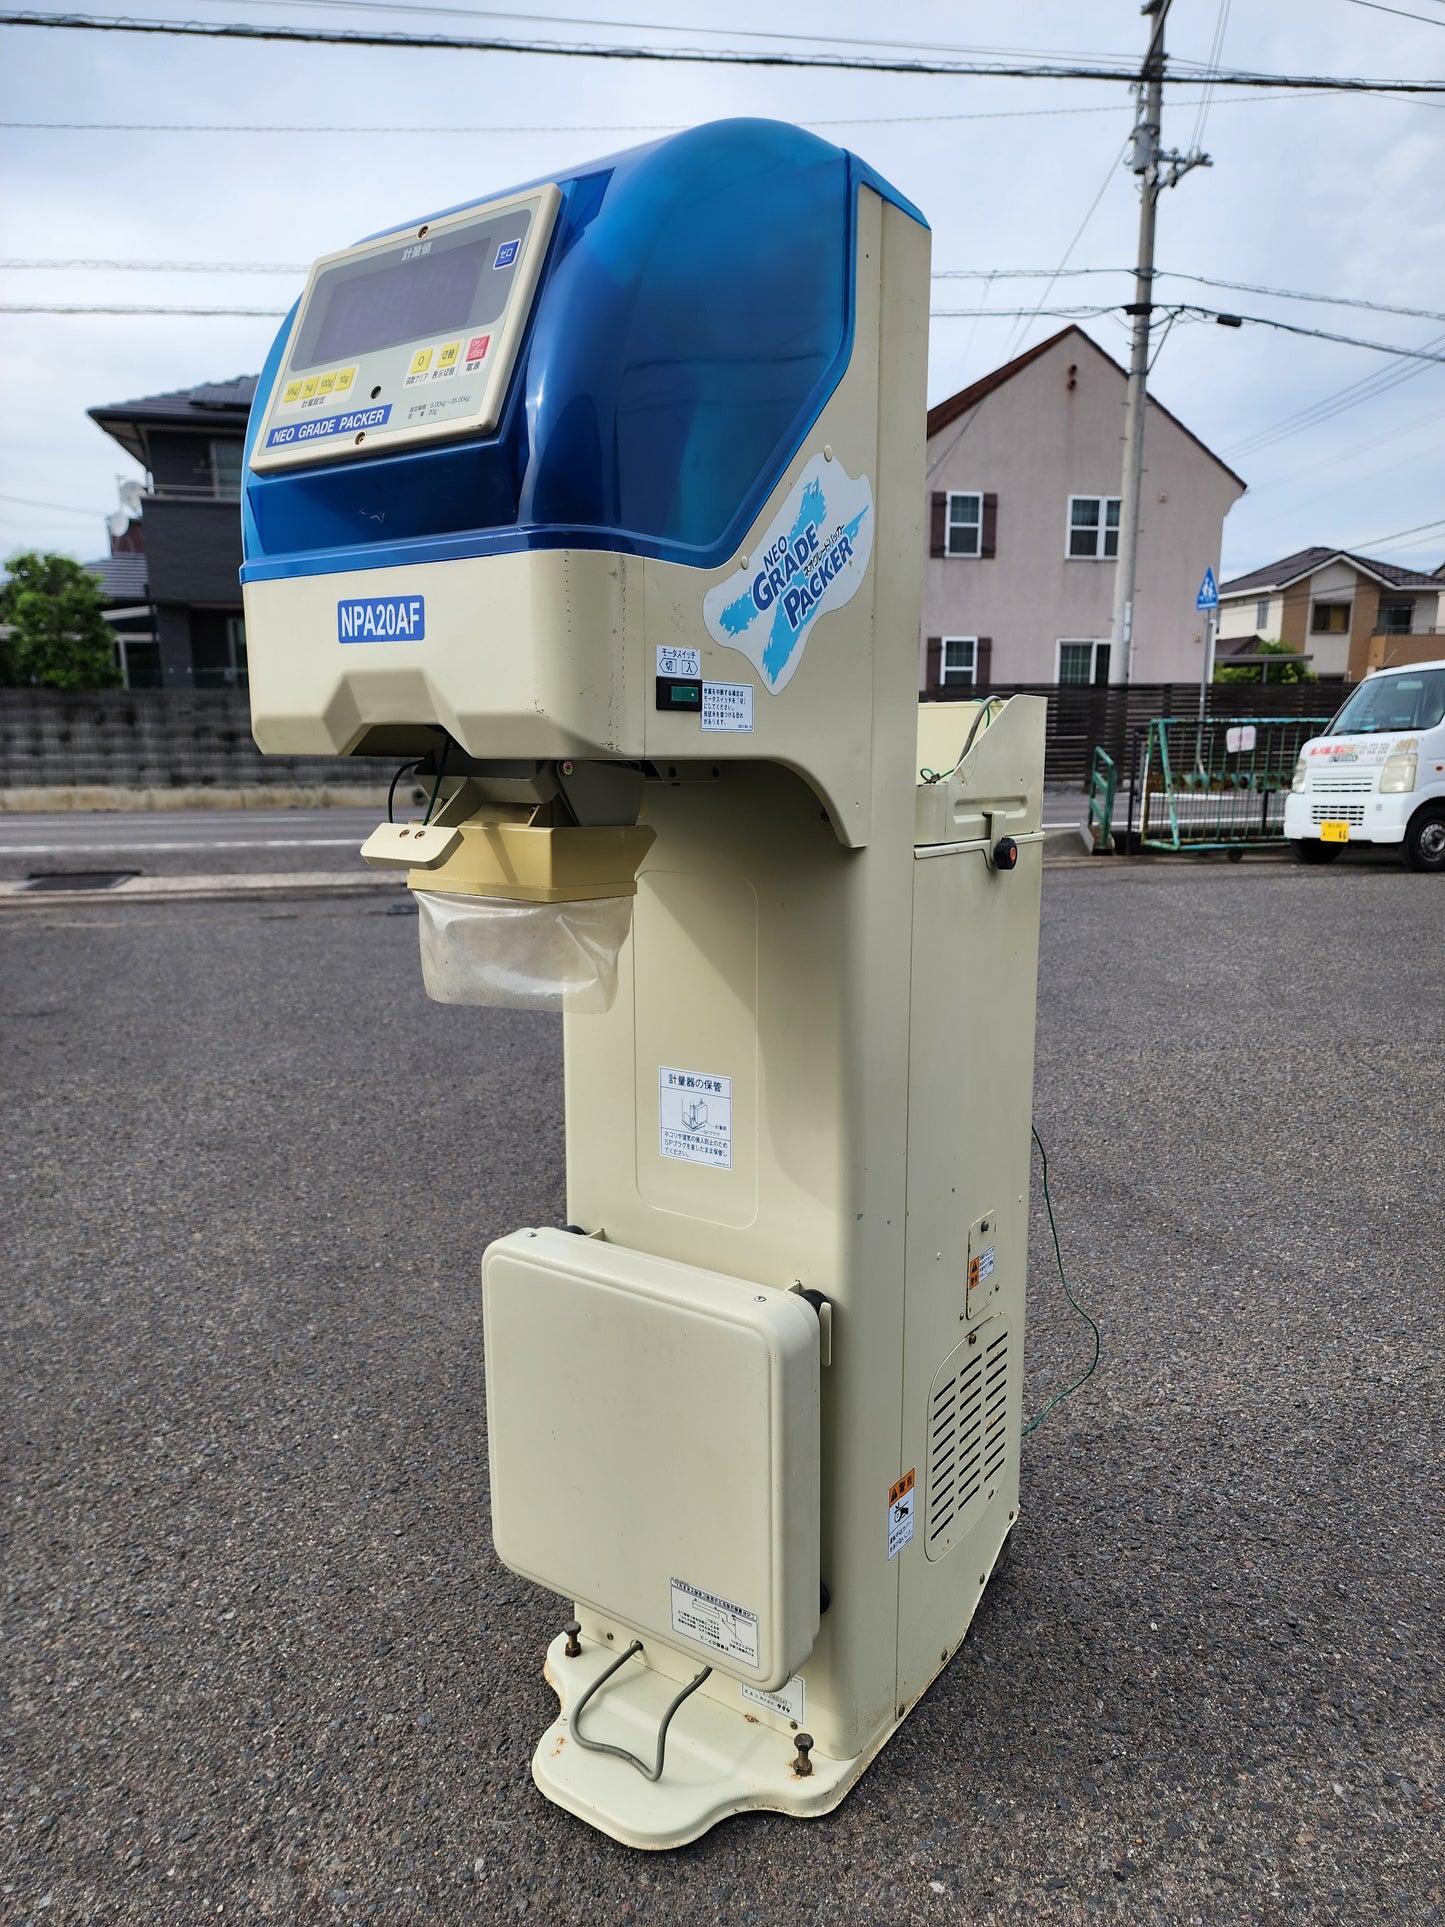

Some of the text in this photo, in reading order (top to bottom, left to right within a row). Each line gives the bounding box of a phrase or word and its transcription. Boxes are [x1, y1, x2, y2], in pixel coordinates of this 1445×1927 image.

[401, 242, 432, 261] 計量値
[500, 248, 514, 259] ゼロ
[432, 367, 455, 379] 表示切替
[466, 362, 480, 371] 電源
[301, 396, 326, 408] 計量設定
[272, 409, 384, 443] NEO GRADE PACKER
[763, 536, 787, 571] NEO
[752, 524, 820, 610] GRADE
[783, 536, 854, 629] PACKER
[341, 602, 419, 637] NPA20AF
[662, 648, 695, 659] モータスイッチ
[665, 661, 693, 673] 切 入
[668, 1074, 722, 1092] 計量器の保管
[899, 1475, 912, 1494] 警告
[777, 1703, 790, 1713] サタケ
